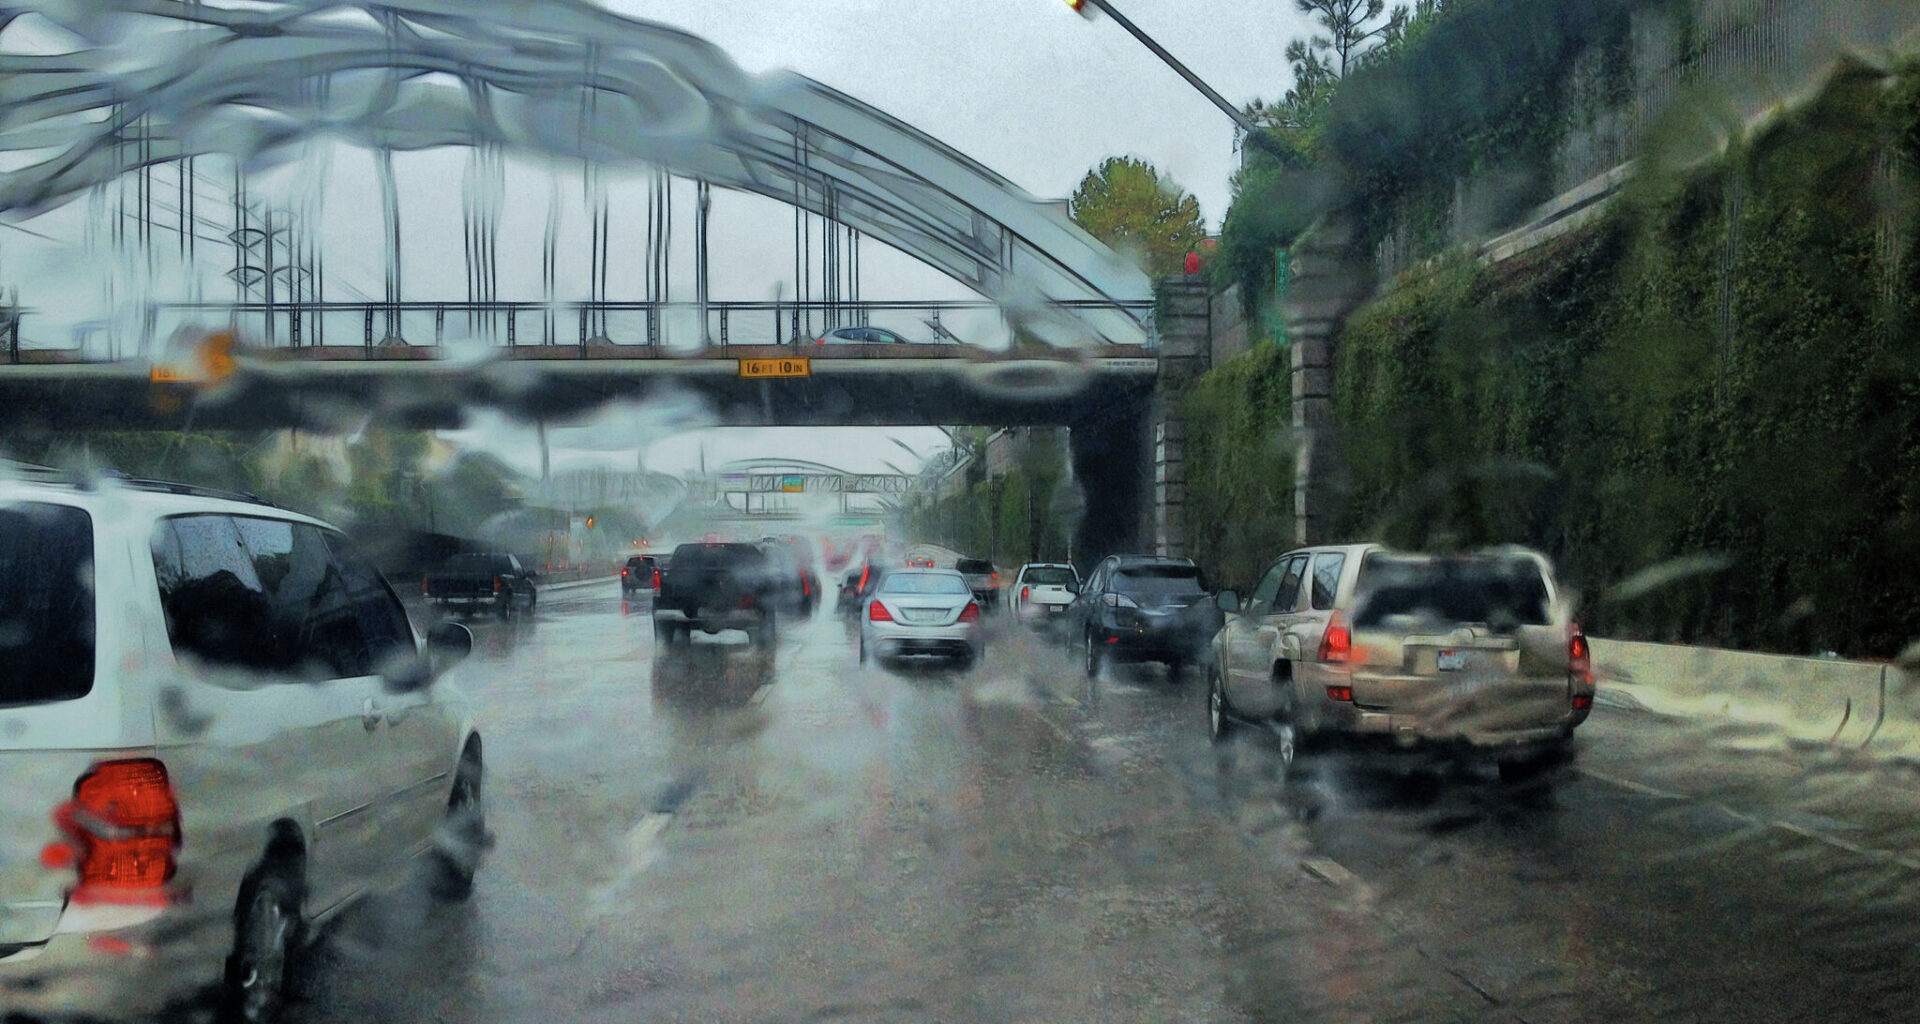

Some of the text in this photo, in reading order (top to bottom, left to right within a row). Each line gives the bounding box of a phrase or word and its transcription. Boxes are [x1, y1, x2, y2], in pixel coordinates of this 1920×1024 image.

[747, 361, 802, 373] 16 FT 10 IN
